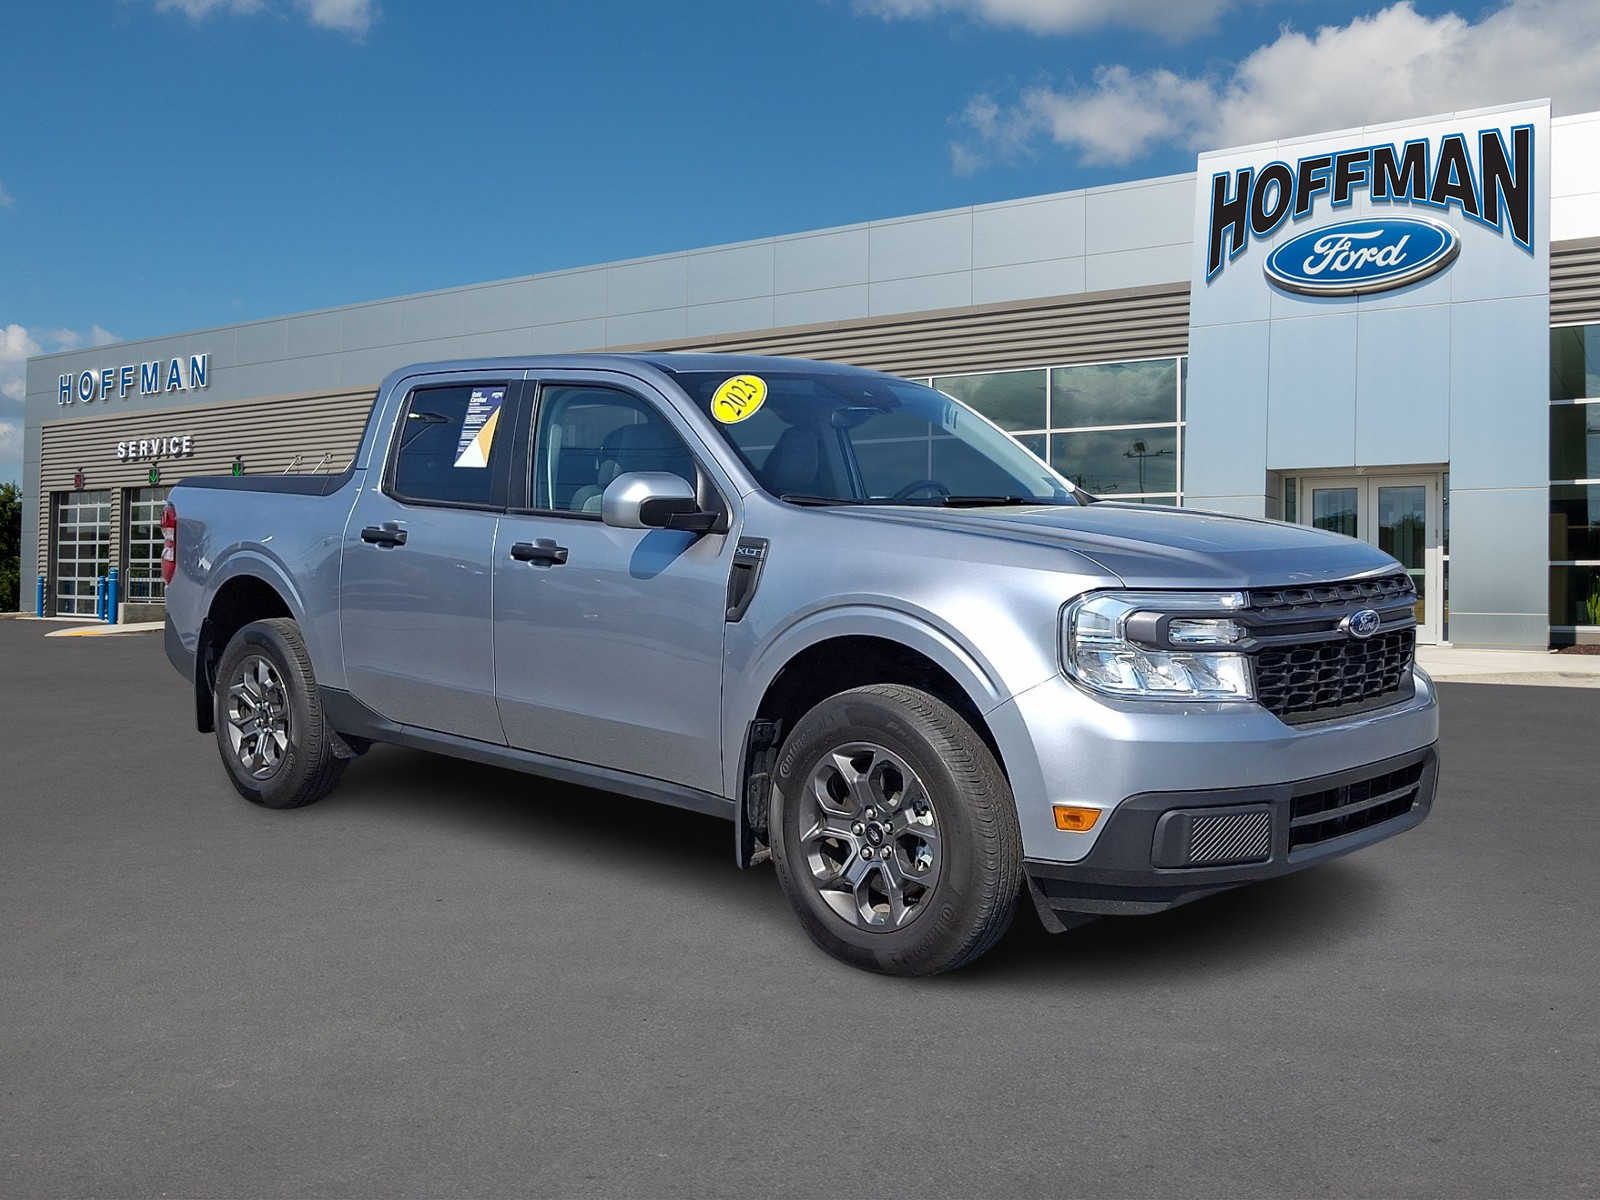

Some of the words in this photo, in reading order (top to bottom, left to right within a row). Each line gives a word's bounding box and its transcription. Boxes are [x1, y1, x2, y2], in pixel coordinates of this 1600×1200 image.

[1206, 123, 1535, 284] HOFFMAN
[1303, 229, 1412, 275] Ford
[58, 354, 208, 405] HOFFMAN
[719, 379, 758, 417] 2023
[117, 435, 192, 458] SERVICE
[736, 547, 761, 556] XLT
